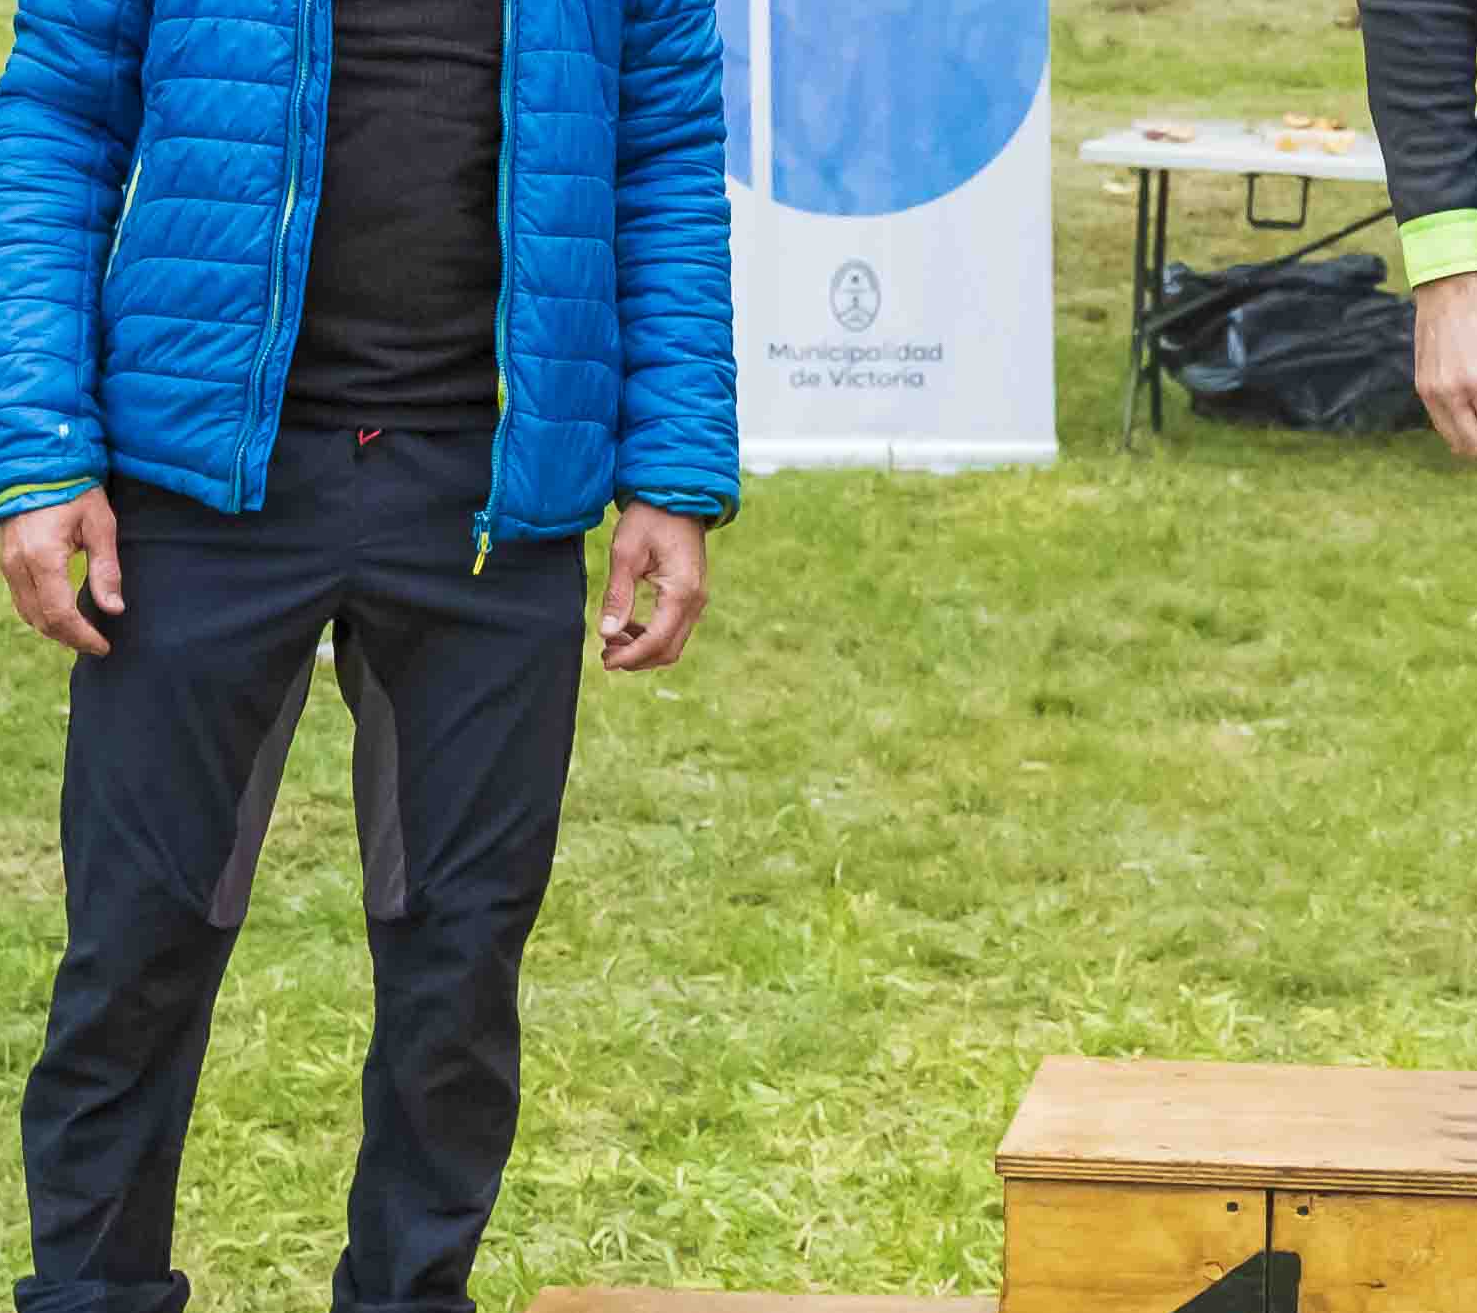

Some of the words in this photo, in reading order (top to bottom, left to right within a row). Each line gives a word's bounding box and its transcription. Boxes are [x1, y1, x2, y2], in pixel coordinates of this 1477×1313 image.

[768, 342, 943, 364] Municipalidad
[790, 370, 821, 388] de
[829, 369, 925, 388] Victoria
